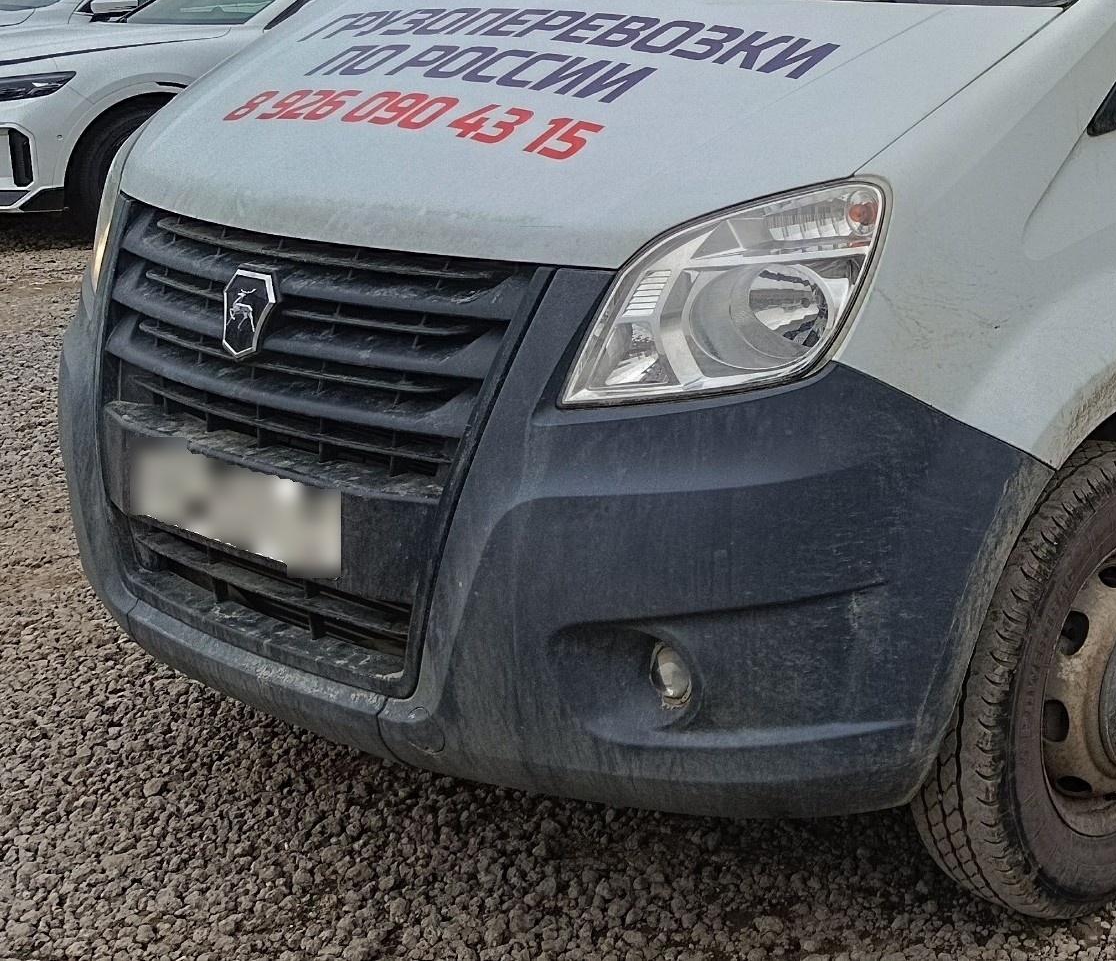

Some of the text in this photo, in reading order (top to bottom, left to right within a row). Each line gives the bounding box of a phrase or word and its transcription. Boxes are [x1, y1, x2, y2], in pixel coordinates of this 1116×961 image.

[297, 7, 841, 80] ГРУЗОПЕРЕВОЗКИ
[303, 44, 658, 104] ПО РОССИИ
[222, 89, 606, 160] 8 926 090 43 15
